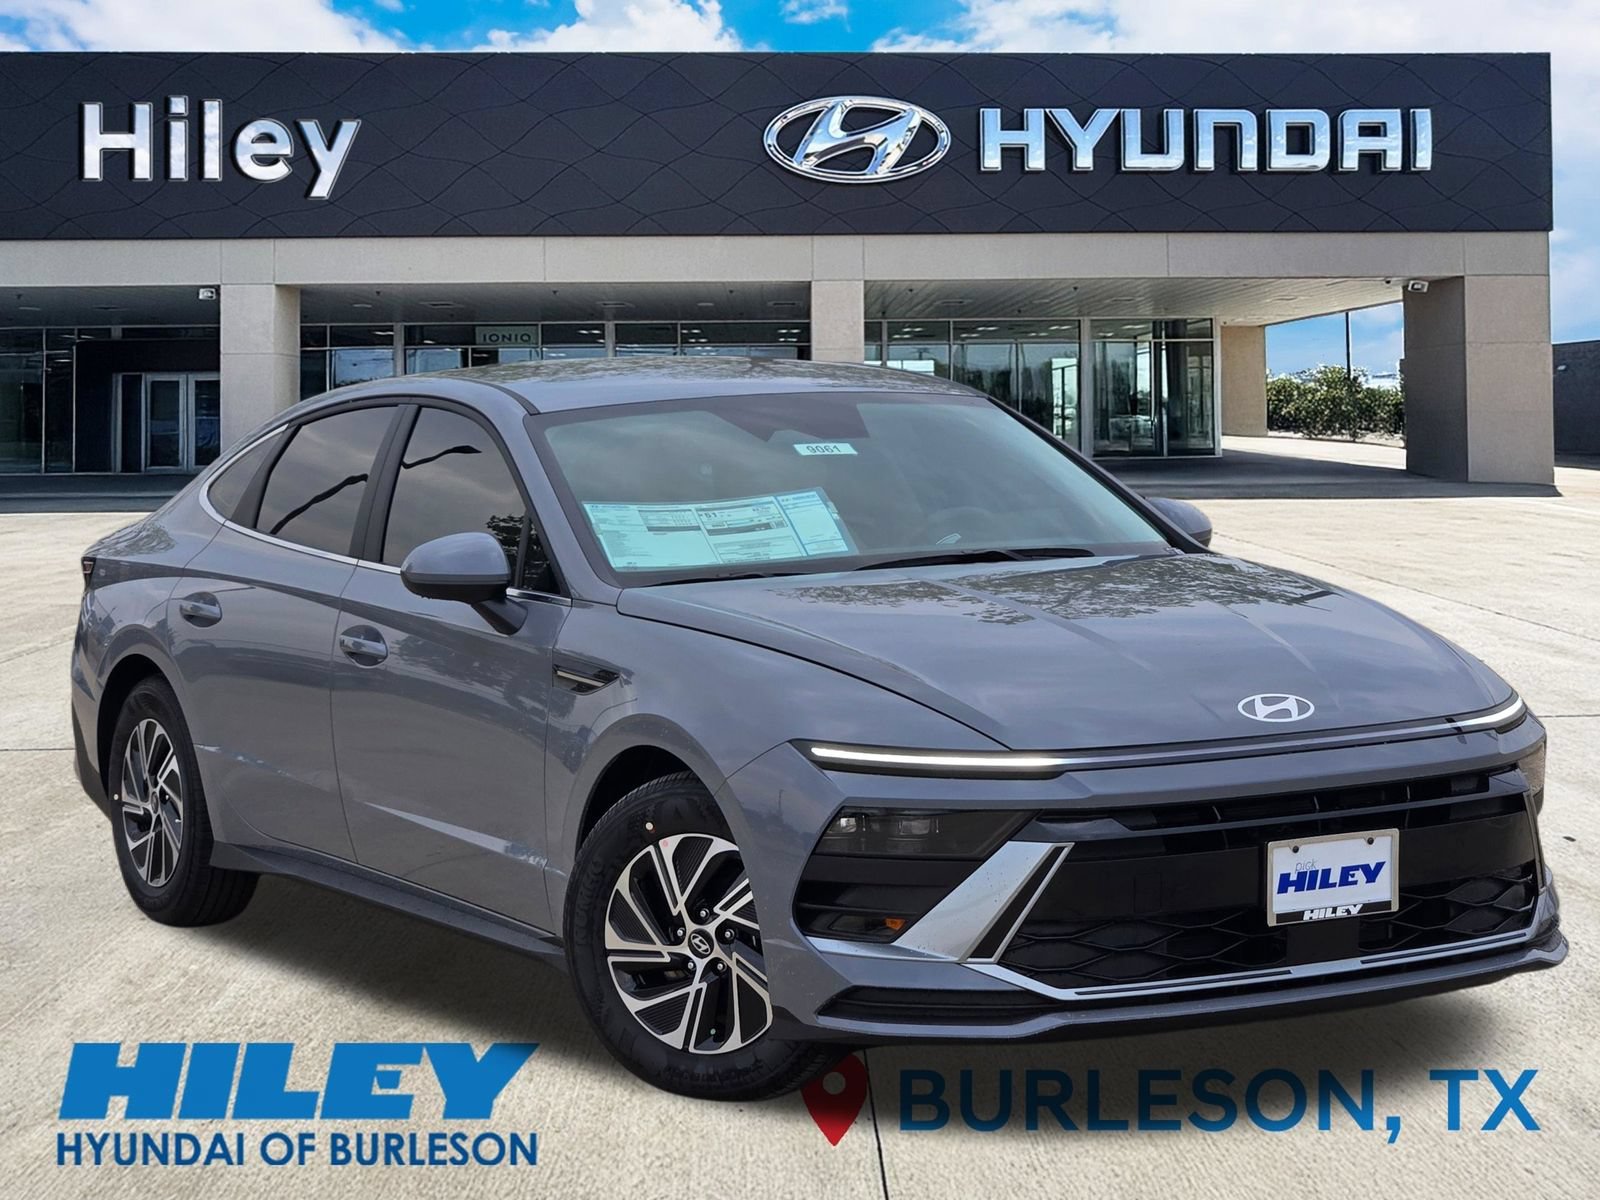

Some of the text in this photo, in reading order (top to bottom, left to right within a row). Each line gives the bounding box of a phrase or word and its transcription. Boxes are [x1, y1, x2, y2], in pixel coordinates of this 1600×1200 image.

[80, 95, 362, 199] Hiley
[978, 108, 1432, 172] HYUNDAI
[482, 332, 532, 343] IONIQ
[806, 444, 841, 454] 9061
[1277, 861, 1386, 894] HILEY
[1303, 903, 1363, 921] HILEY
